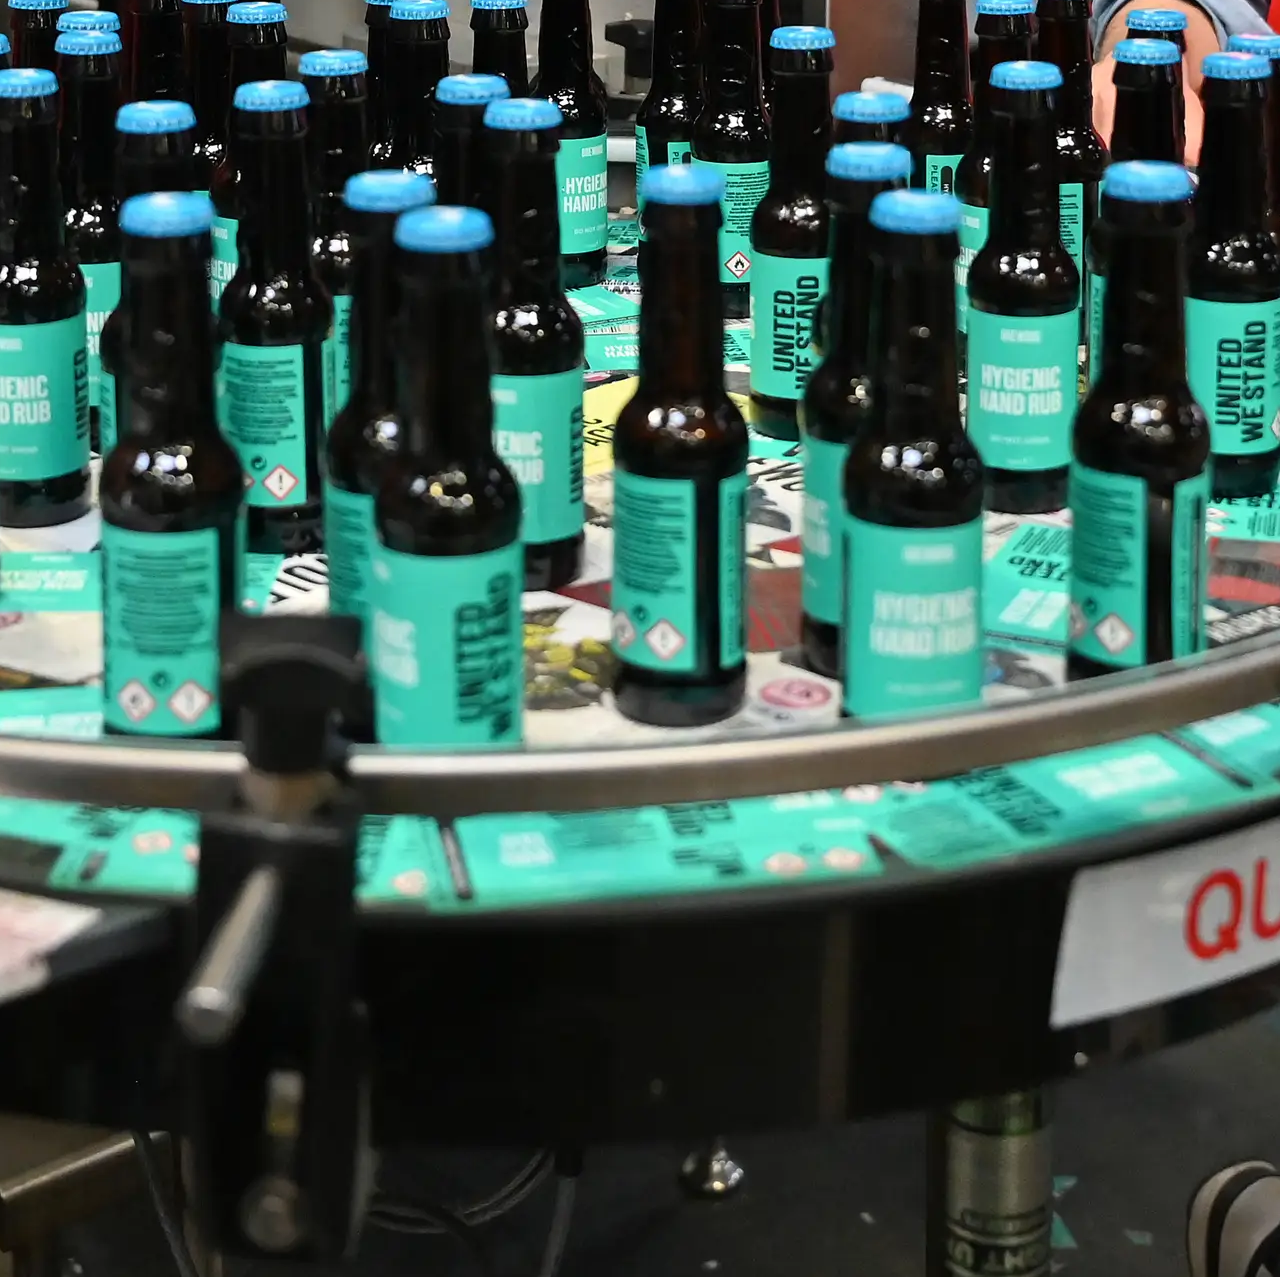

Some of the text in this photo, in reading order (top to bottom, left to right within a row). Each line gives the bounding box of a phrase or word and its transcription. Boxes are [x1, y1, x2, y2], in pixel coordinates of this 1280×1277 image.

[563, 189, 608, 213] HAND RU
[565, 170, 608, 195] HYGIEN
[773, 289, 796, 373] UNITED
[795, 275, 820, 351] STAND
[979, 389, 1063, 416] HAND RUB
[981, 364, 1062, 391] HYGIENIC
[1215, 338, 1242, 425] UNITED
[1241, 321, 1267, 443] WE STAND
[13, 399, 51, 425] RUB
[455, 601, 486, 725] UNITED
